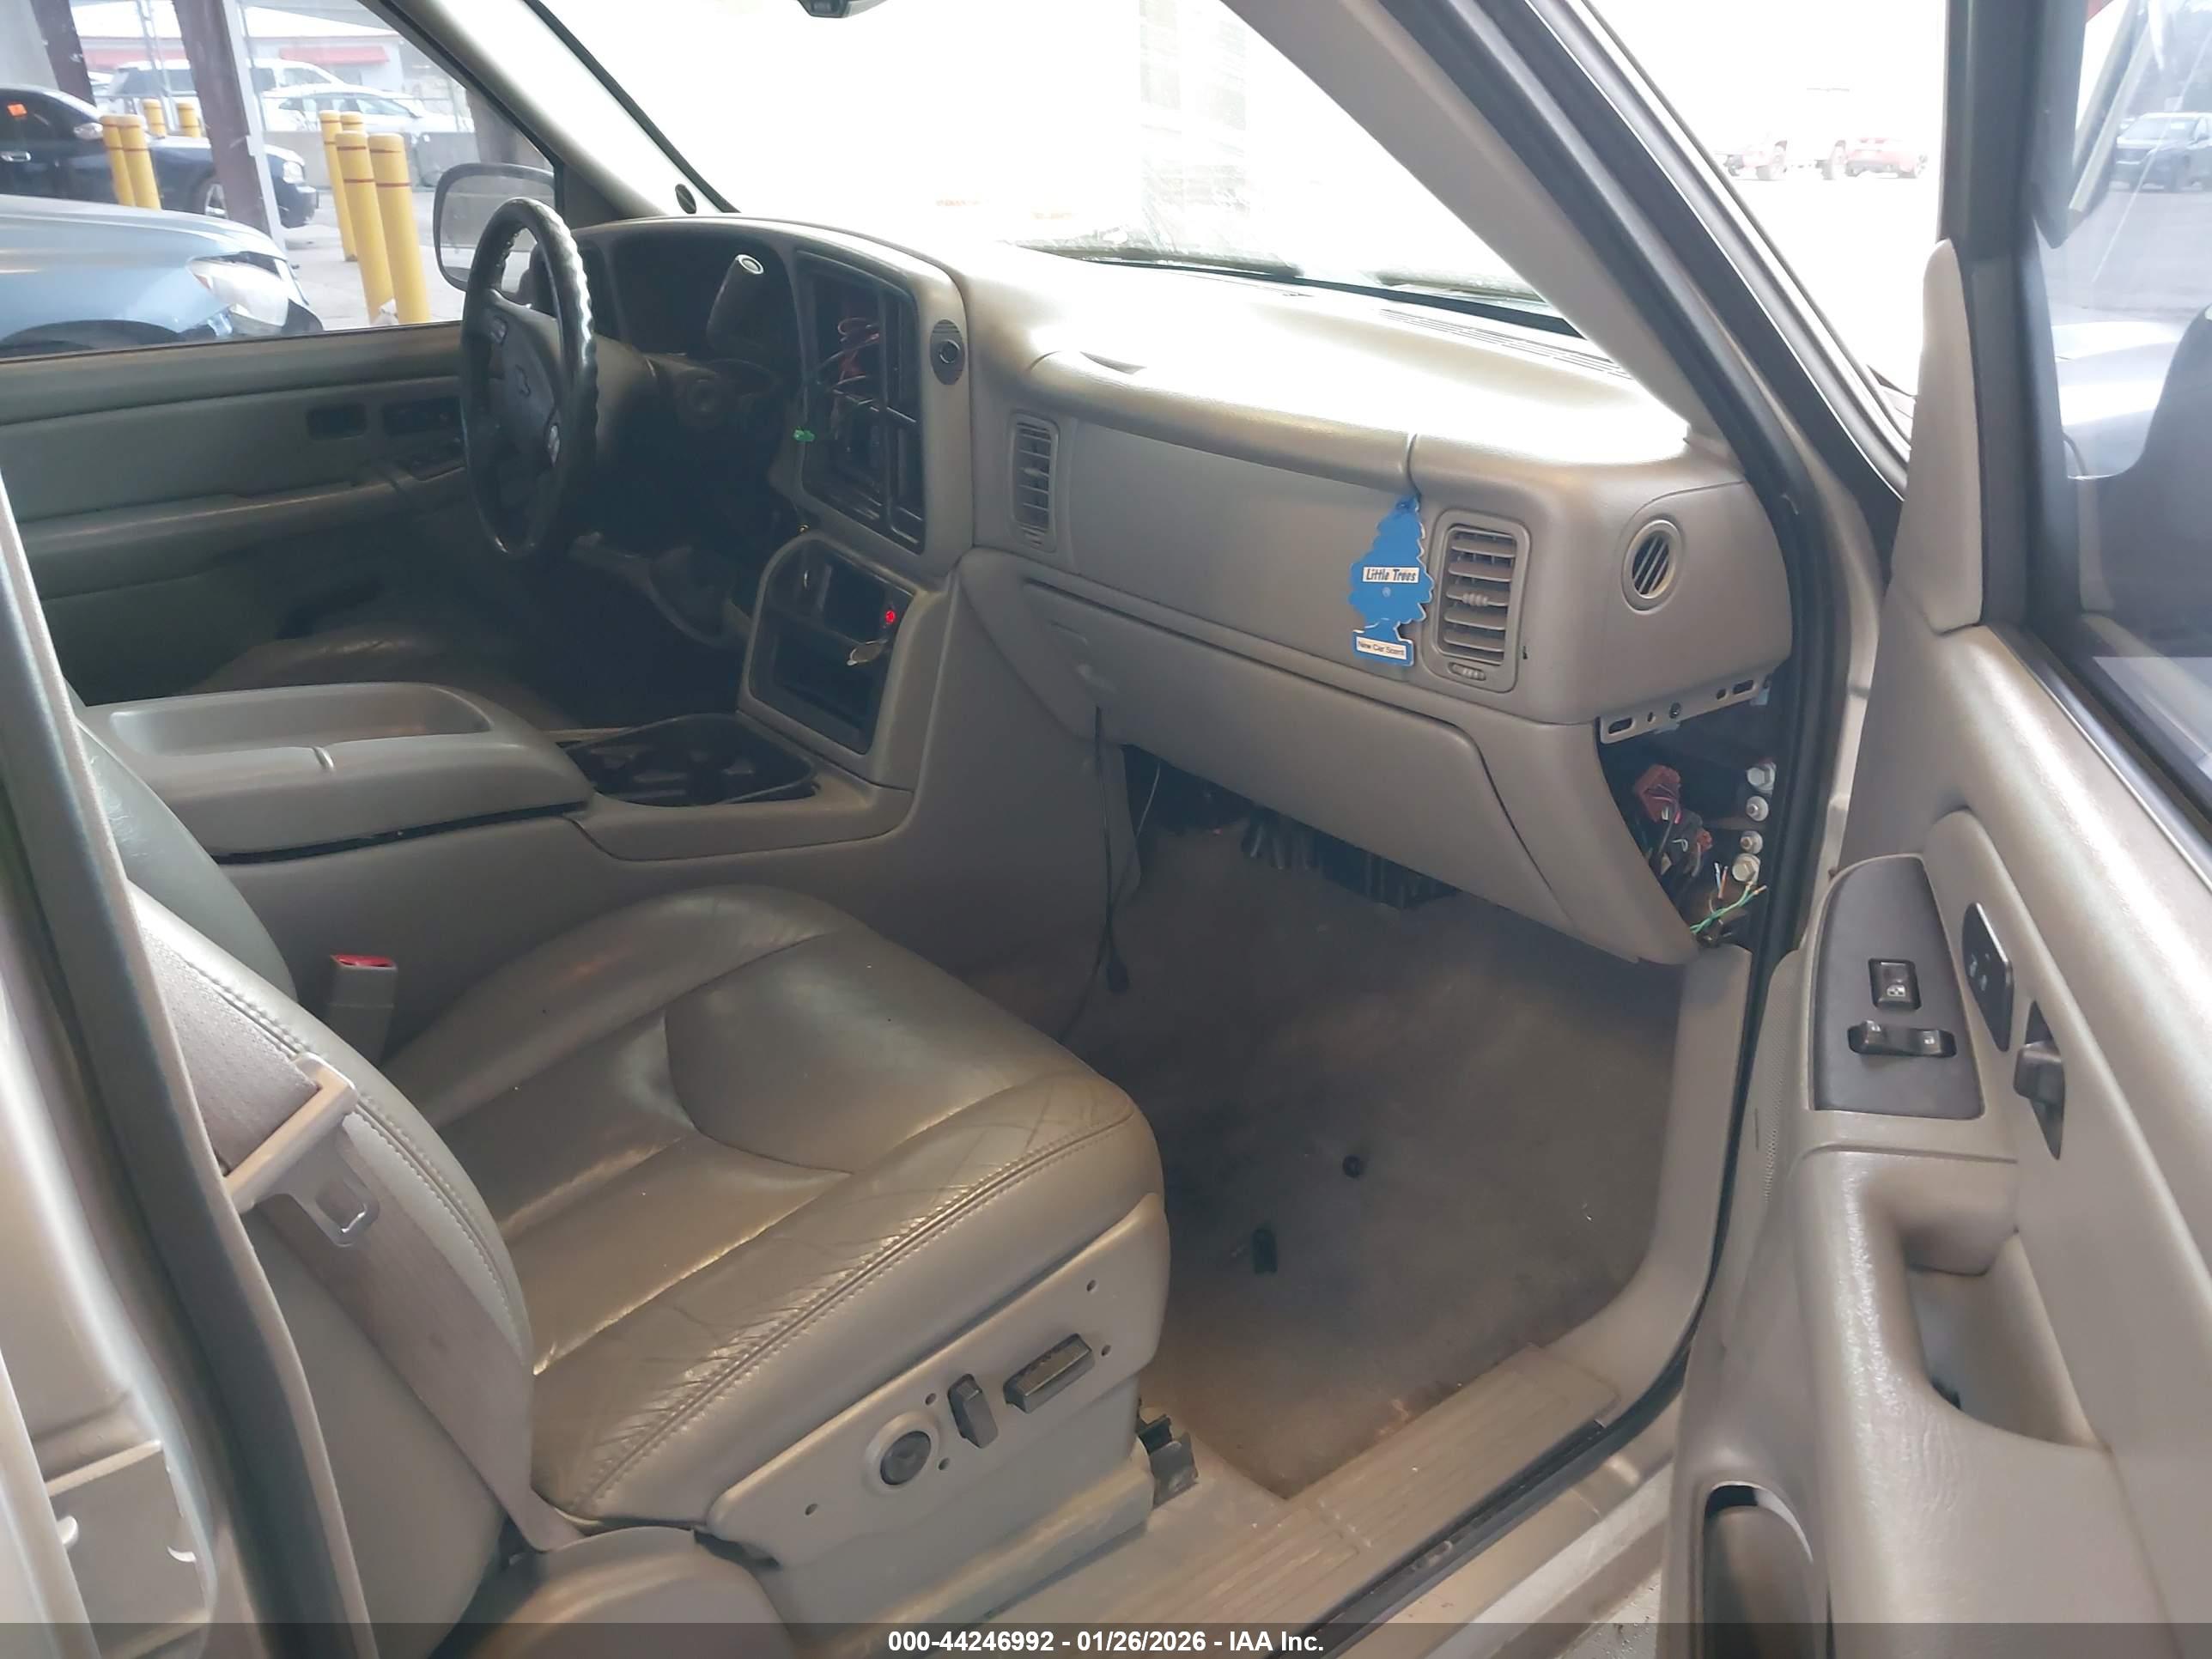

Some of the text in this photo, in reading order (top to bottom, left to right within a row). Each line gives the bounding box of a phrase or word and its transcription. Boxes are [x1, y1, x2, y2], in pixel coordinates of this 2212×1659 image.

[1366, 568, 1416, 581] Little Trees
[1358, 641, 1405, 656] New Car Scent
